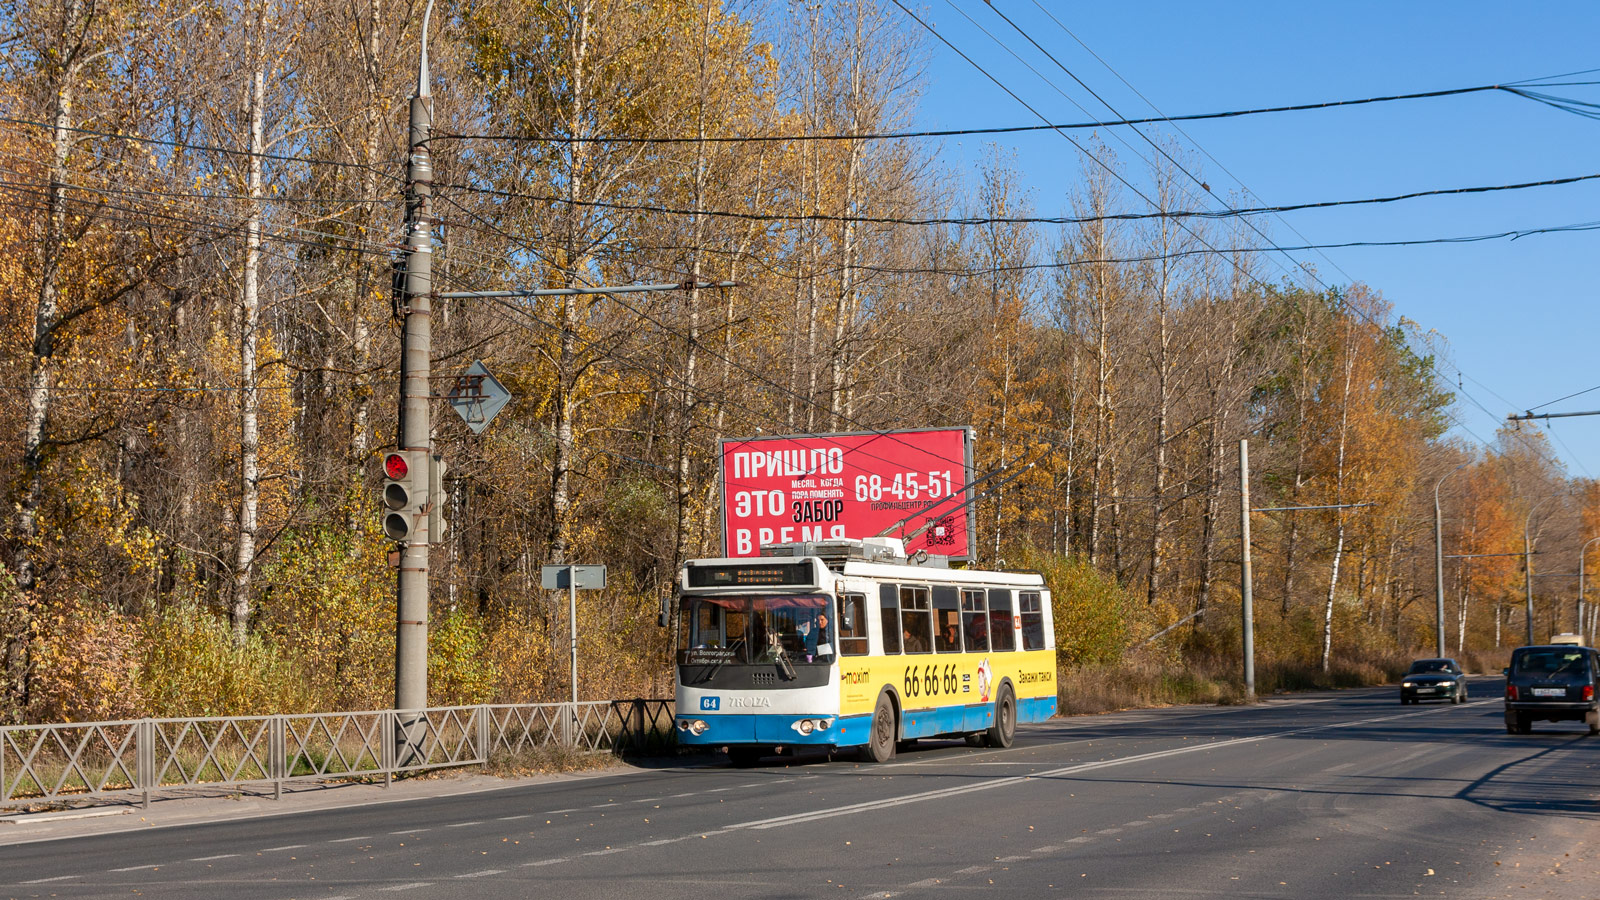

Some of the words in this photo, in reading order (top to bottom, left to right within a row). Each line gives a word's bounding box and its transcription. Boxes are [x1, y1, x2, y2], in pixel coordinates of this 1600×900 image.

[734, 448, 843, 479] ПРИШЛО
[820, 478, 844, 487] КОГДА
[855, 470, 951, 502] 68-45-51
[791, 490, 809, 499] ПОРА
[809, 489, 844, 499] ПОМЕНЯТЬ
[735, 490, 785, 518] ЭТО
[791, 499, 844, 523] ЗАБОР
[845, 667, 870, 684] maxim
[1018, 669, 1038, 684] Закажи
[703, 698, 717, 708] 64
